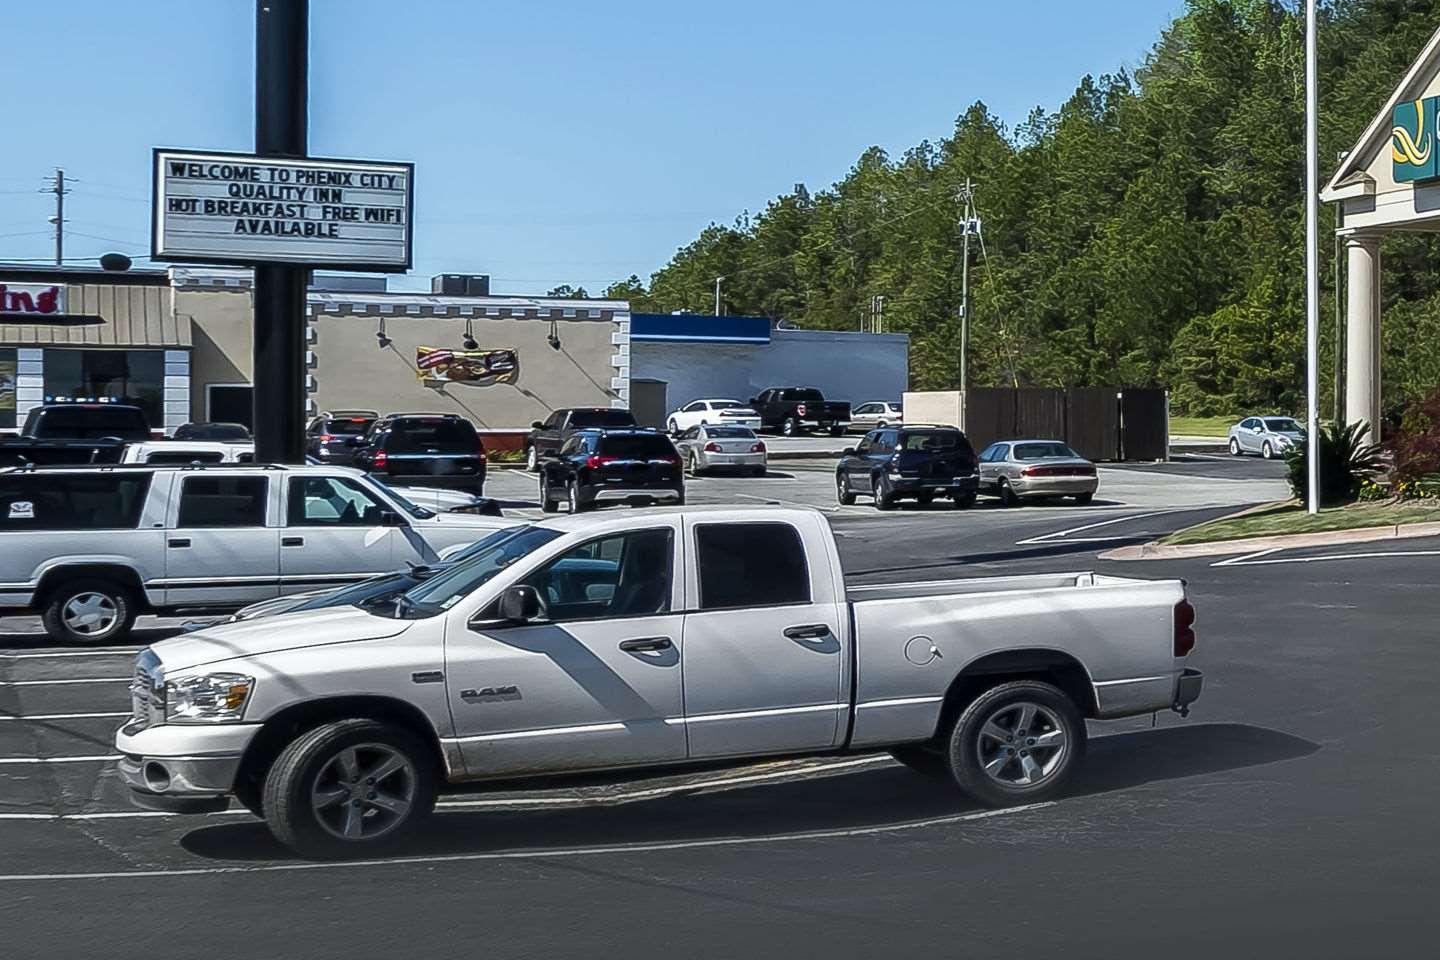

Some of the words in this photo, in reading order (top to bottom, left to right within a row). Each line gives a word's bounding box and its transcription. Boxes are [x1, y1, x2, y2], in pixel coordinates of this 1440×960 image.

[170, 162, 260, 181] WELCOME
[267, 167, 290, 182] TO
[296, 169, 353, 186] PHENIX
[360, 173, 396, 189] CITY
[228, 183, 306, 201] QUALITY
[313, 187, 342, 203] INN
[168, 198, 200, 212] HOT
[204, 199, 308, 218] BREAKFAST
[322, 205, 360, 221] FREE
[364, 207, 401, 223] WIFI
[234, 219, 339, 237] AVAILABLE
